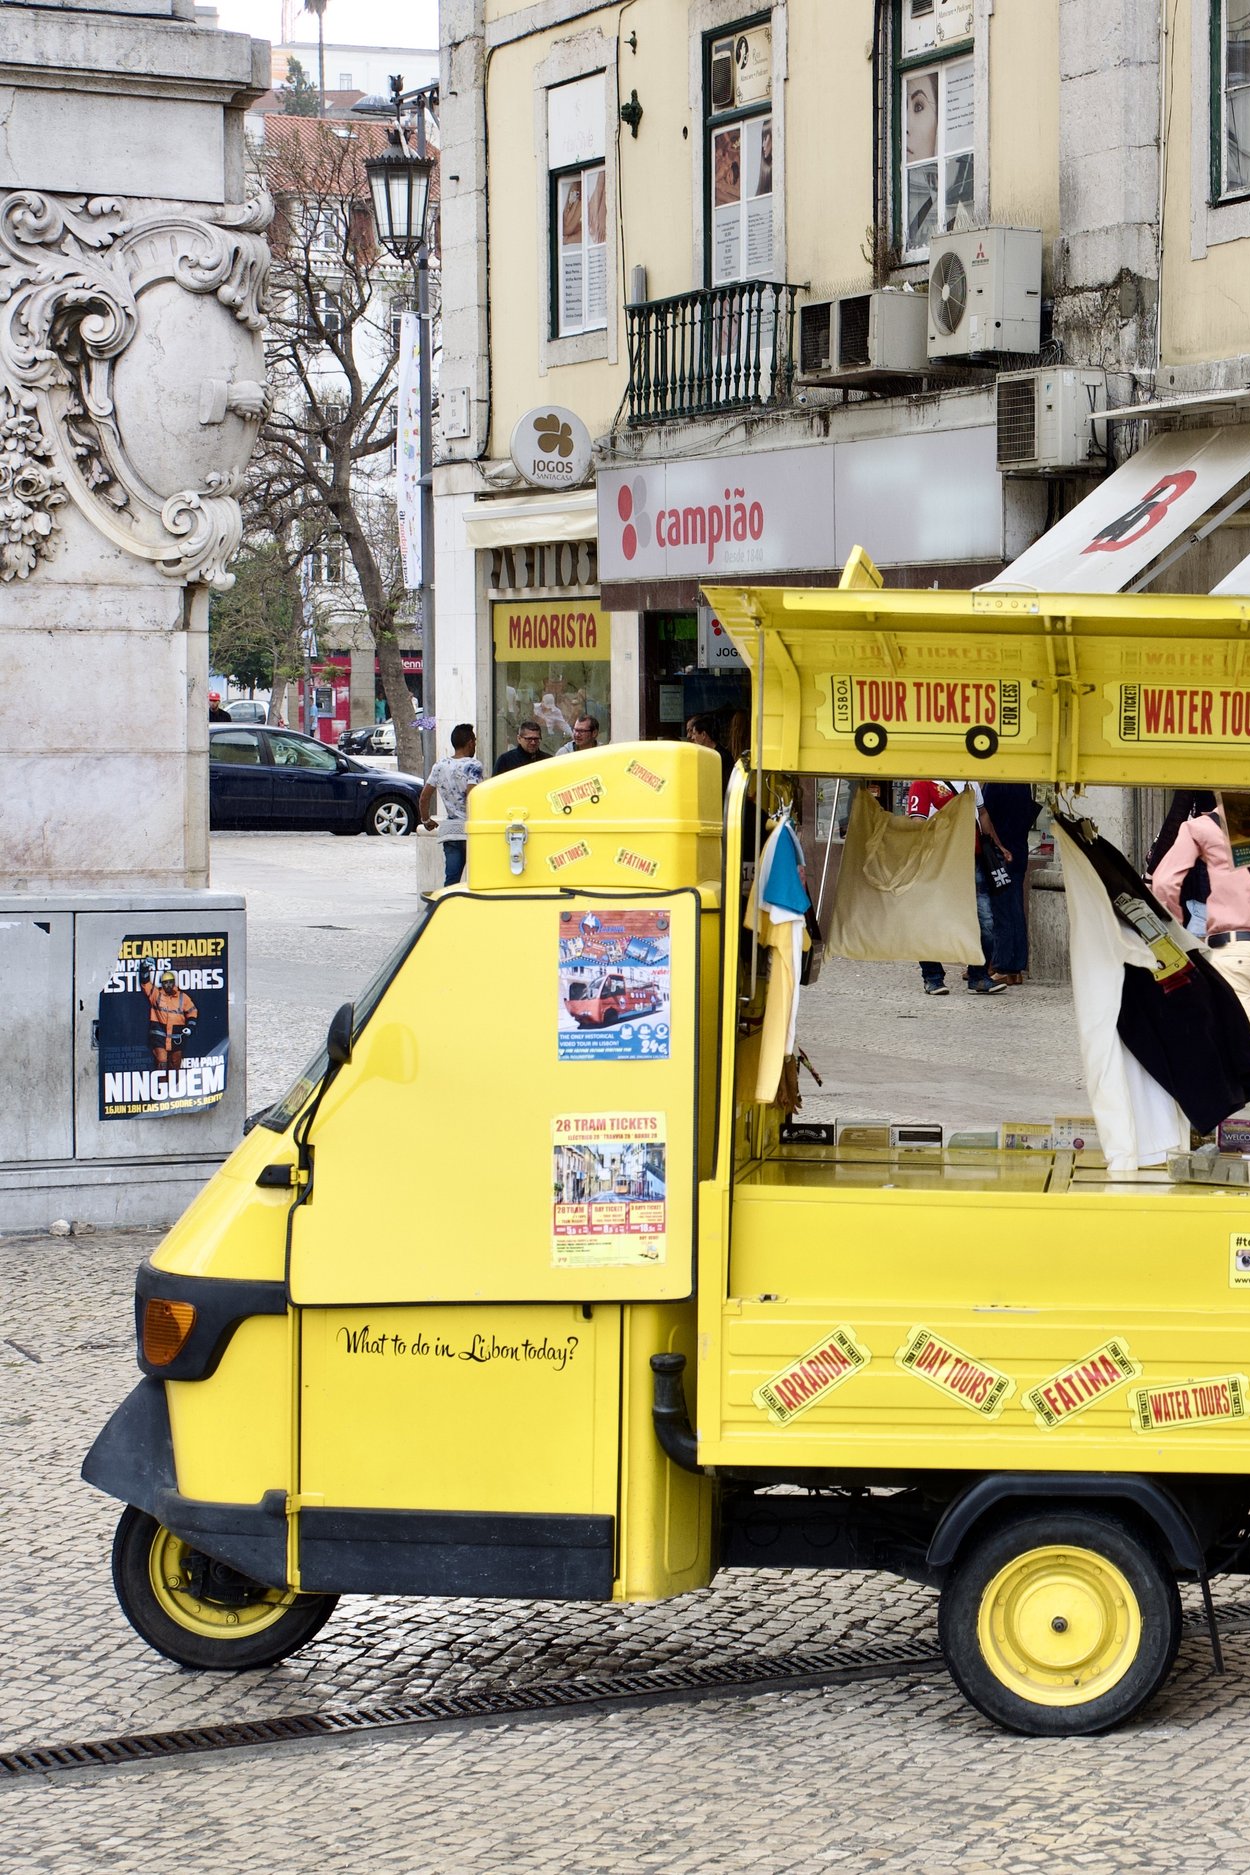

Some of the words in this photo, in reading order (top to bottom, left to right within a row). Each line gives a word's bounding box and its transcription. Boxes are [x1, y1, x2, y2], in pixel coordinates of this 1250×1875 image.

[532, 459, 573, 476] JOGOS
[655, 487, 764, 565] campião
[724, 547, 745, 564] Desde
[746, 547, 764, 564] 1840
[509, 612, 597, 649] MAIORISTA
[837, 679, 849, 722] LISBOA
[855, 680, 908, 722] TOUR
[912, 682, 997, 725] TICKETS
[1002, 683, 1019, 704] LESS
[1123, 684, 1138, 714] TICKETS
[1002, 704, 1018, 726] FOR
[1143, 688, 1214, 736] WATER
[1123, 715, 1137, 737] TOUR
[553, 855, 566, 868] DAY
[564, 845, 585, 863] TOURS
[156, 958, 172, 971] OS
[180, 1057, 200, 1069] NEM
[200, 1055, 225, 1068] PARA
[142, 1101, 159, 1113] CAIS
[555, 1119, 571, 1132] 28
[574, 1118, 606, 1132] TRAM
[609, 1117, 658, 1131] TICKETS
[336, 1324, 389, 1356] What
[391, 1334, 407, 1357] to
[411, 1332, 430, 1356] do
[435, 1337, 456, 1358] in
[458, 1333, 521, 1363] Lisbon
[521, 1336, 579, 1372] today?
[773, 1343, 851, 1411] ARRÁBIDA
[915, 1341, 950, 1377] DAY
[943, 1357, 995, 1404] TOURS
[1150, 1389, 1193, 1423] WATER
[1191, 1383, 1231, 1418] TOURS
